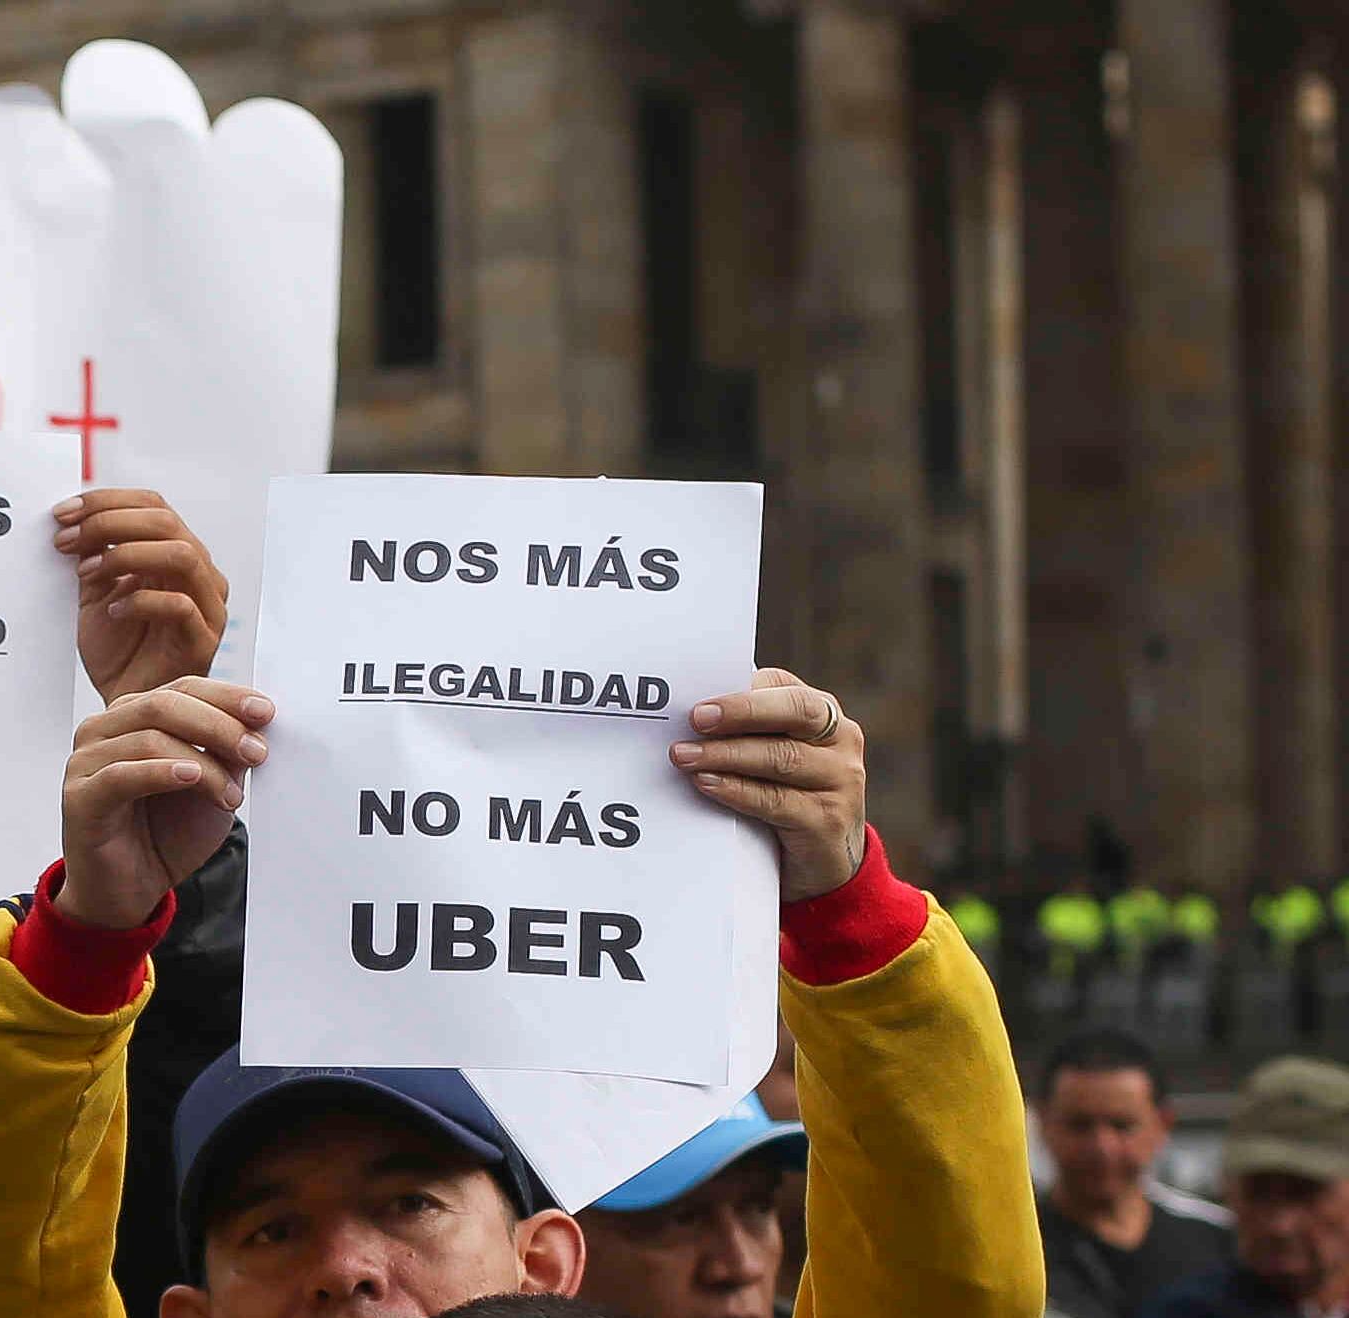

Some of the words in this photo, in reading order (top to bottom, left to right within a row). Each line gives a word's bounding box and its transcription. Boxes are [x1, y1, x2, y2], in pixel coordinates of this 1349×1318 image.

[349, 539, 499, 584] NOS
[526, 535, 680, 592] MÁS
[342, 662, 670, 712] ILEGALIDAD
[358, 789, 461, 837] NO
[488, 790, 641, 849] MÁS
[350, 902, 646, 982] UBER
